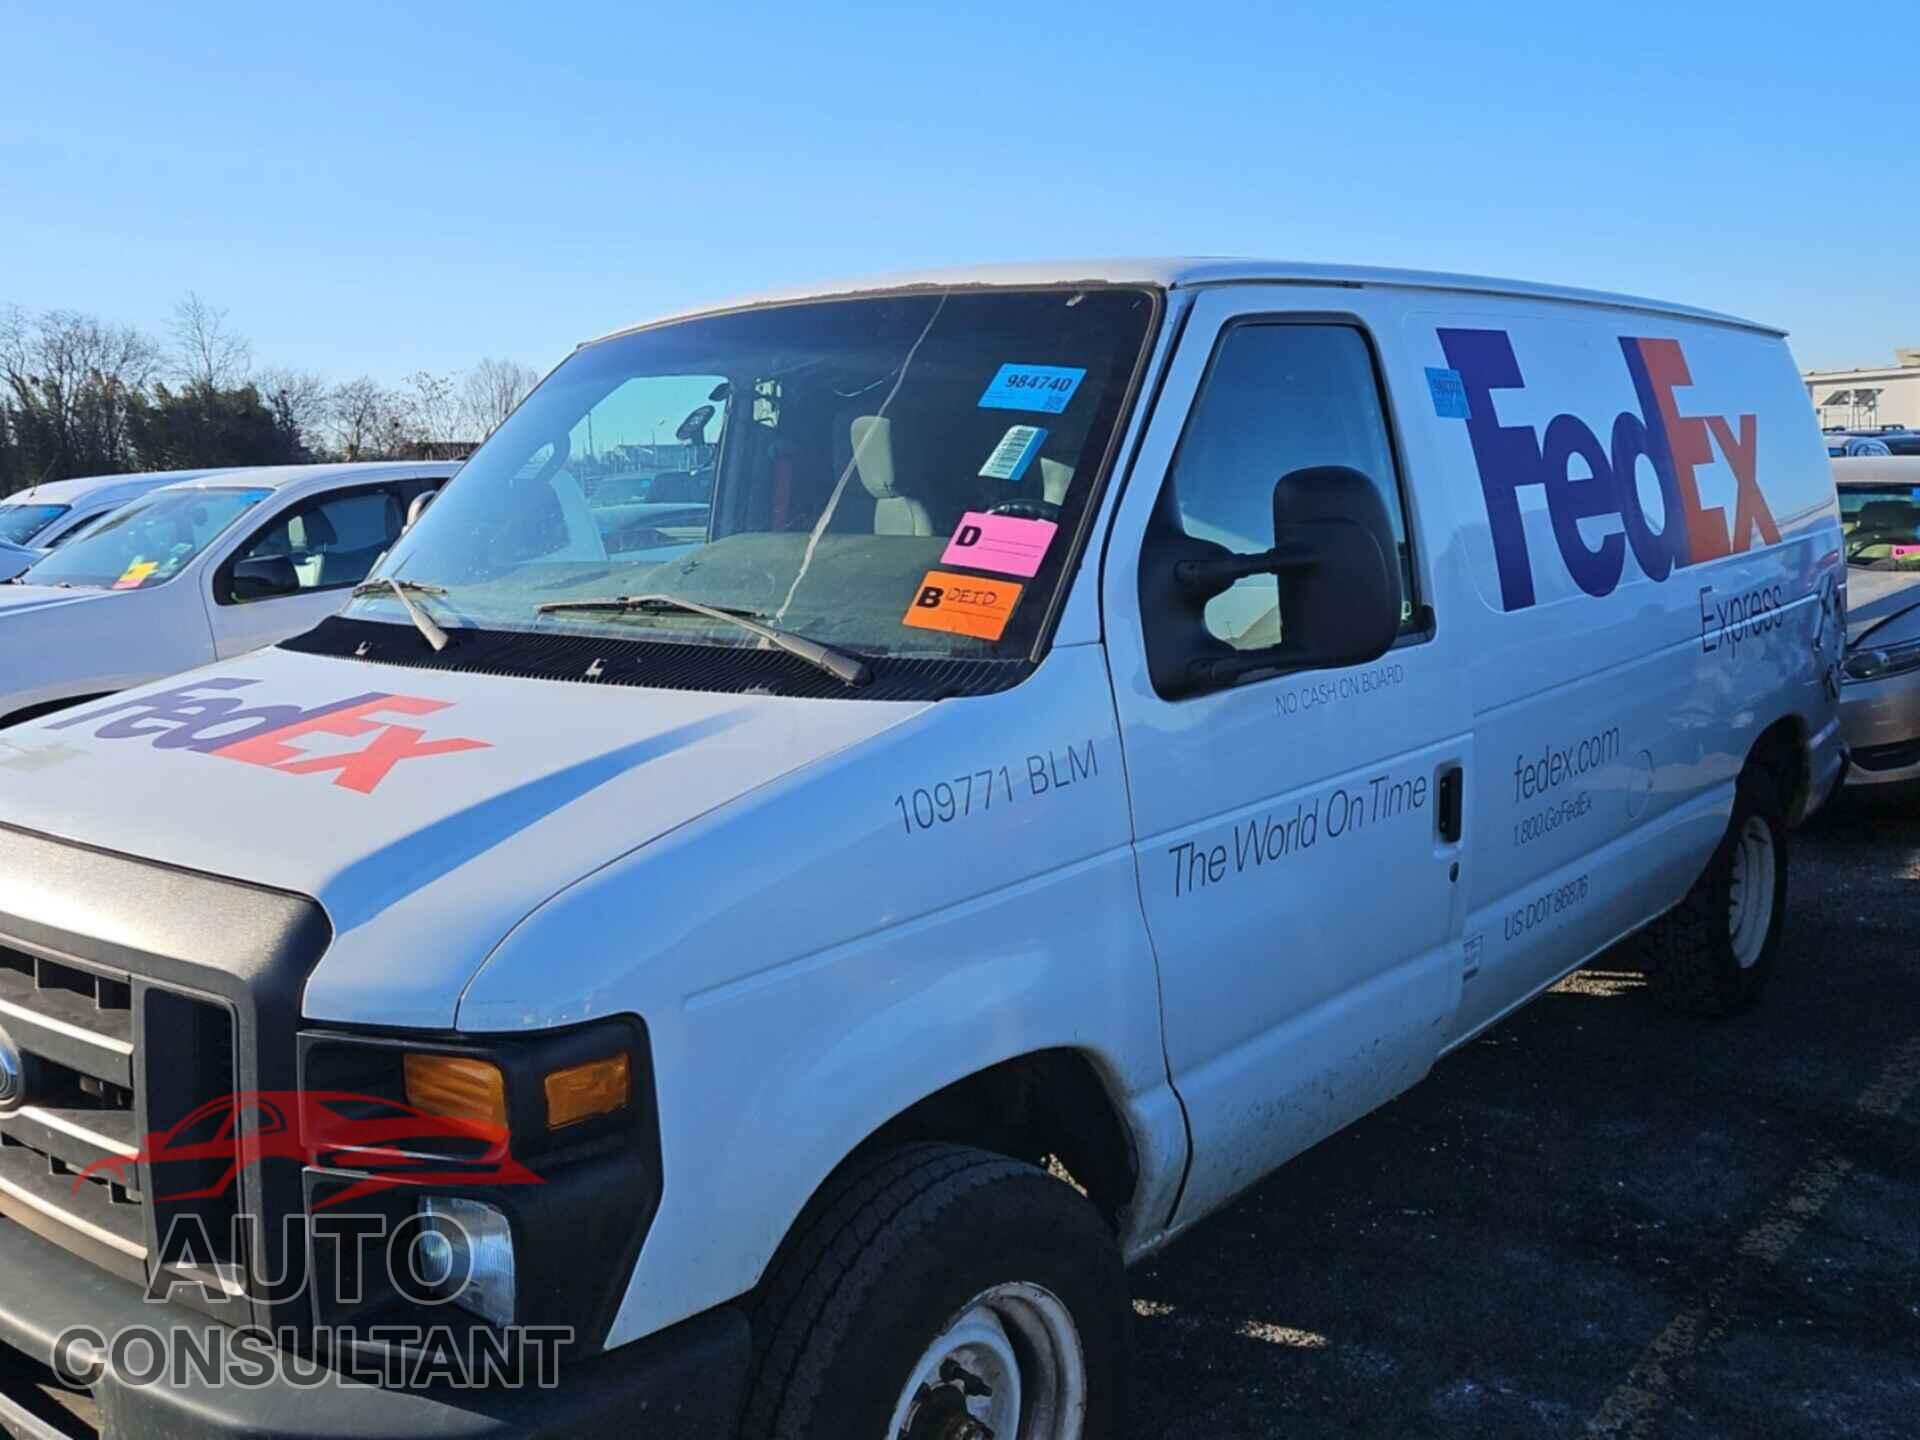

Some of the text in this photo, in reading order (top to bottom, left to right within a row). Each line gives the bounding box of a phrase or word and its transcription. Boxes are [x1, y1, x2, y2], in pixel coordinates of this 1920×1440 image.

[1006, 374, 1073, 392] 984740
[1436, 327, 1783, 613] FedEx
[956, 526, 982, 547] D
[917, 587, 944, 608] B
[1700, 583, 1784, 658] Express
[1275, 664, 1404, 717] NO CASH ON BOARD
[44, 677, 495, 795] FedEx
[1513, 727, 1620, 803] fedex.com
[894, 739, 1099, 834] 109771 BLM
[1169, 775, 1427, 897] The World On Time
[1504, 910, 1523, 941] US
[1526, 893, 1552, 928] DOT
